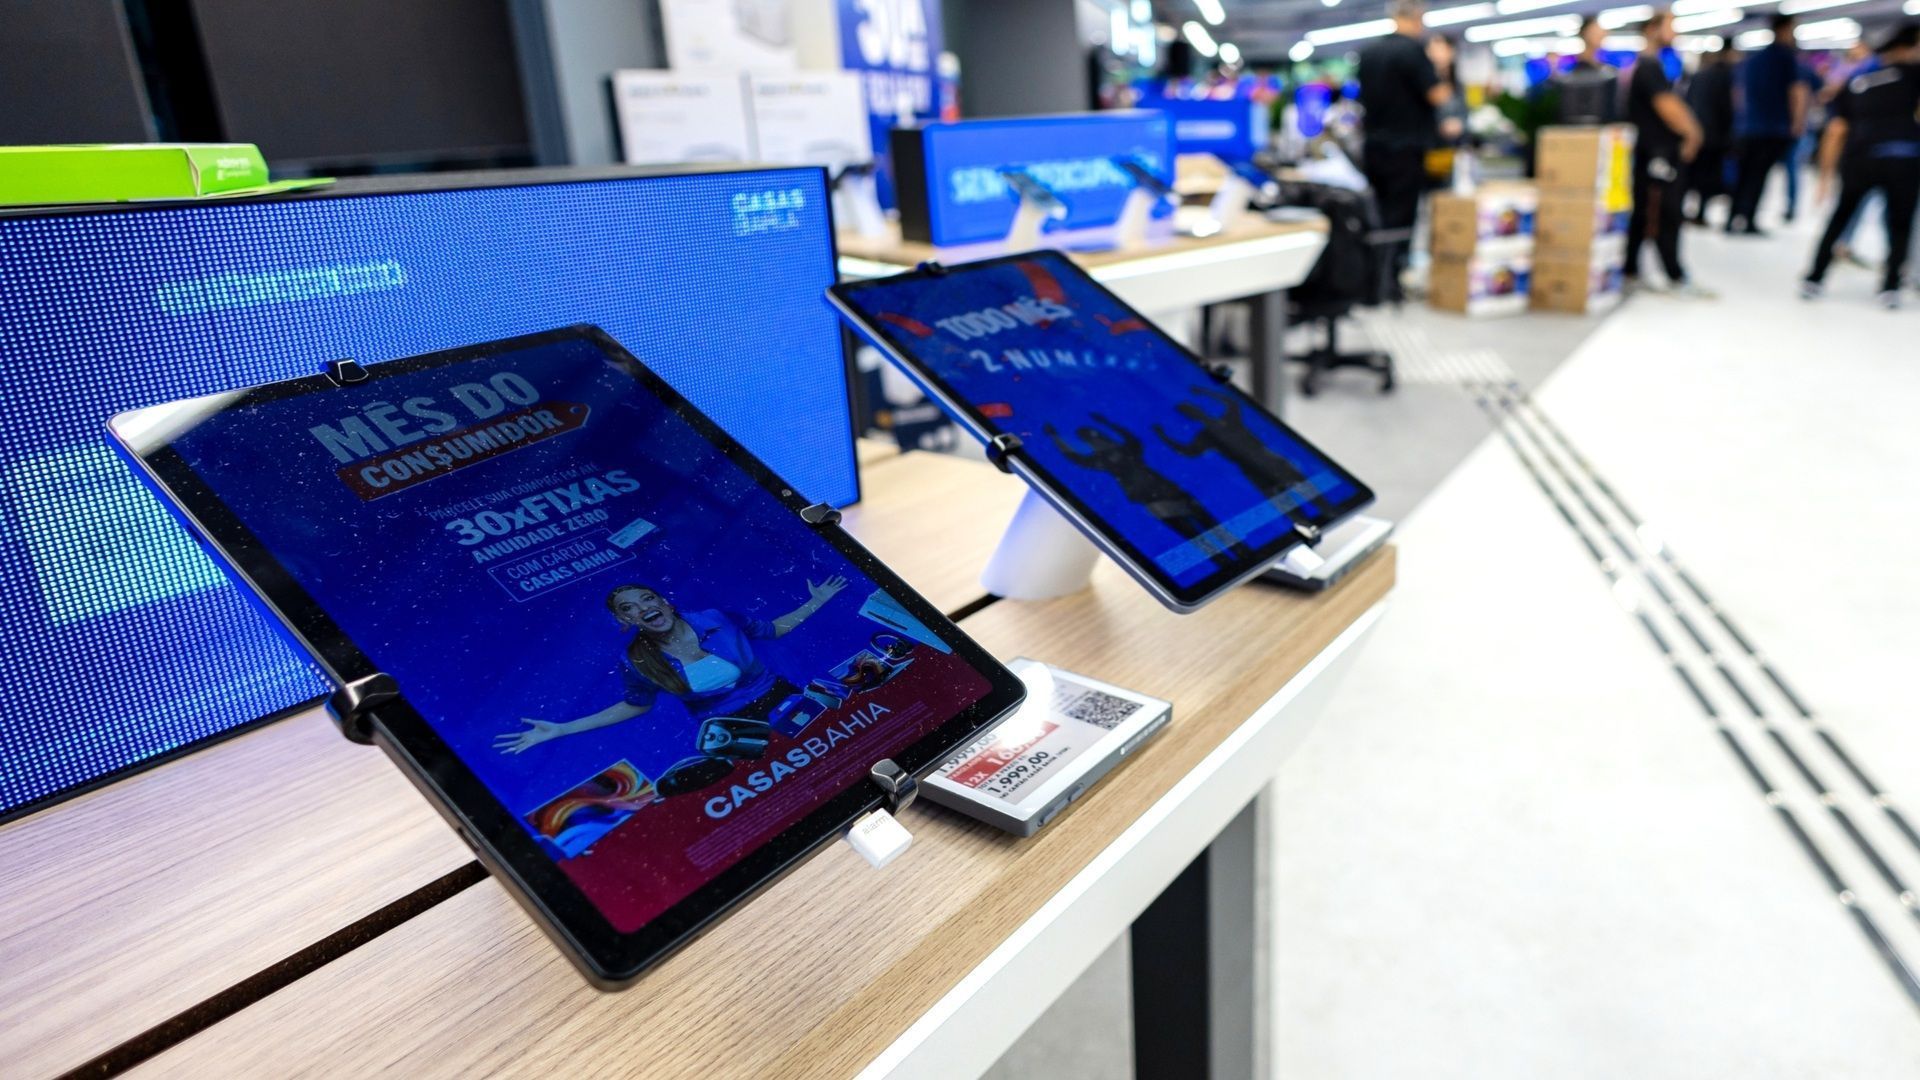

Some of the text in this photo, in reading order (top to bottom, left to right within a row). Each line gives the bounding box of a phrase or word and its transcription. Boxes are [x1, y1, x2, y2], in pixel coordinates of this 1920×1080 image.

[934, 306, 1019, 342] TODO
[309, 371, 542, 464] MÊS DO
[428, 494, 492, 522] PARCELE
[486, 486, 518, 505] SUA
[471, 508, 610, 564] ANUIDADE ZERO
[505, 539, 597, 579] COM CARTÃO
[518, 547, 622, 593] CASAS BAHIA
[963, 770, 989, 787] 12X
[988, 751, 1049, 793] 1.999,00
